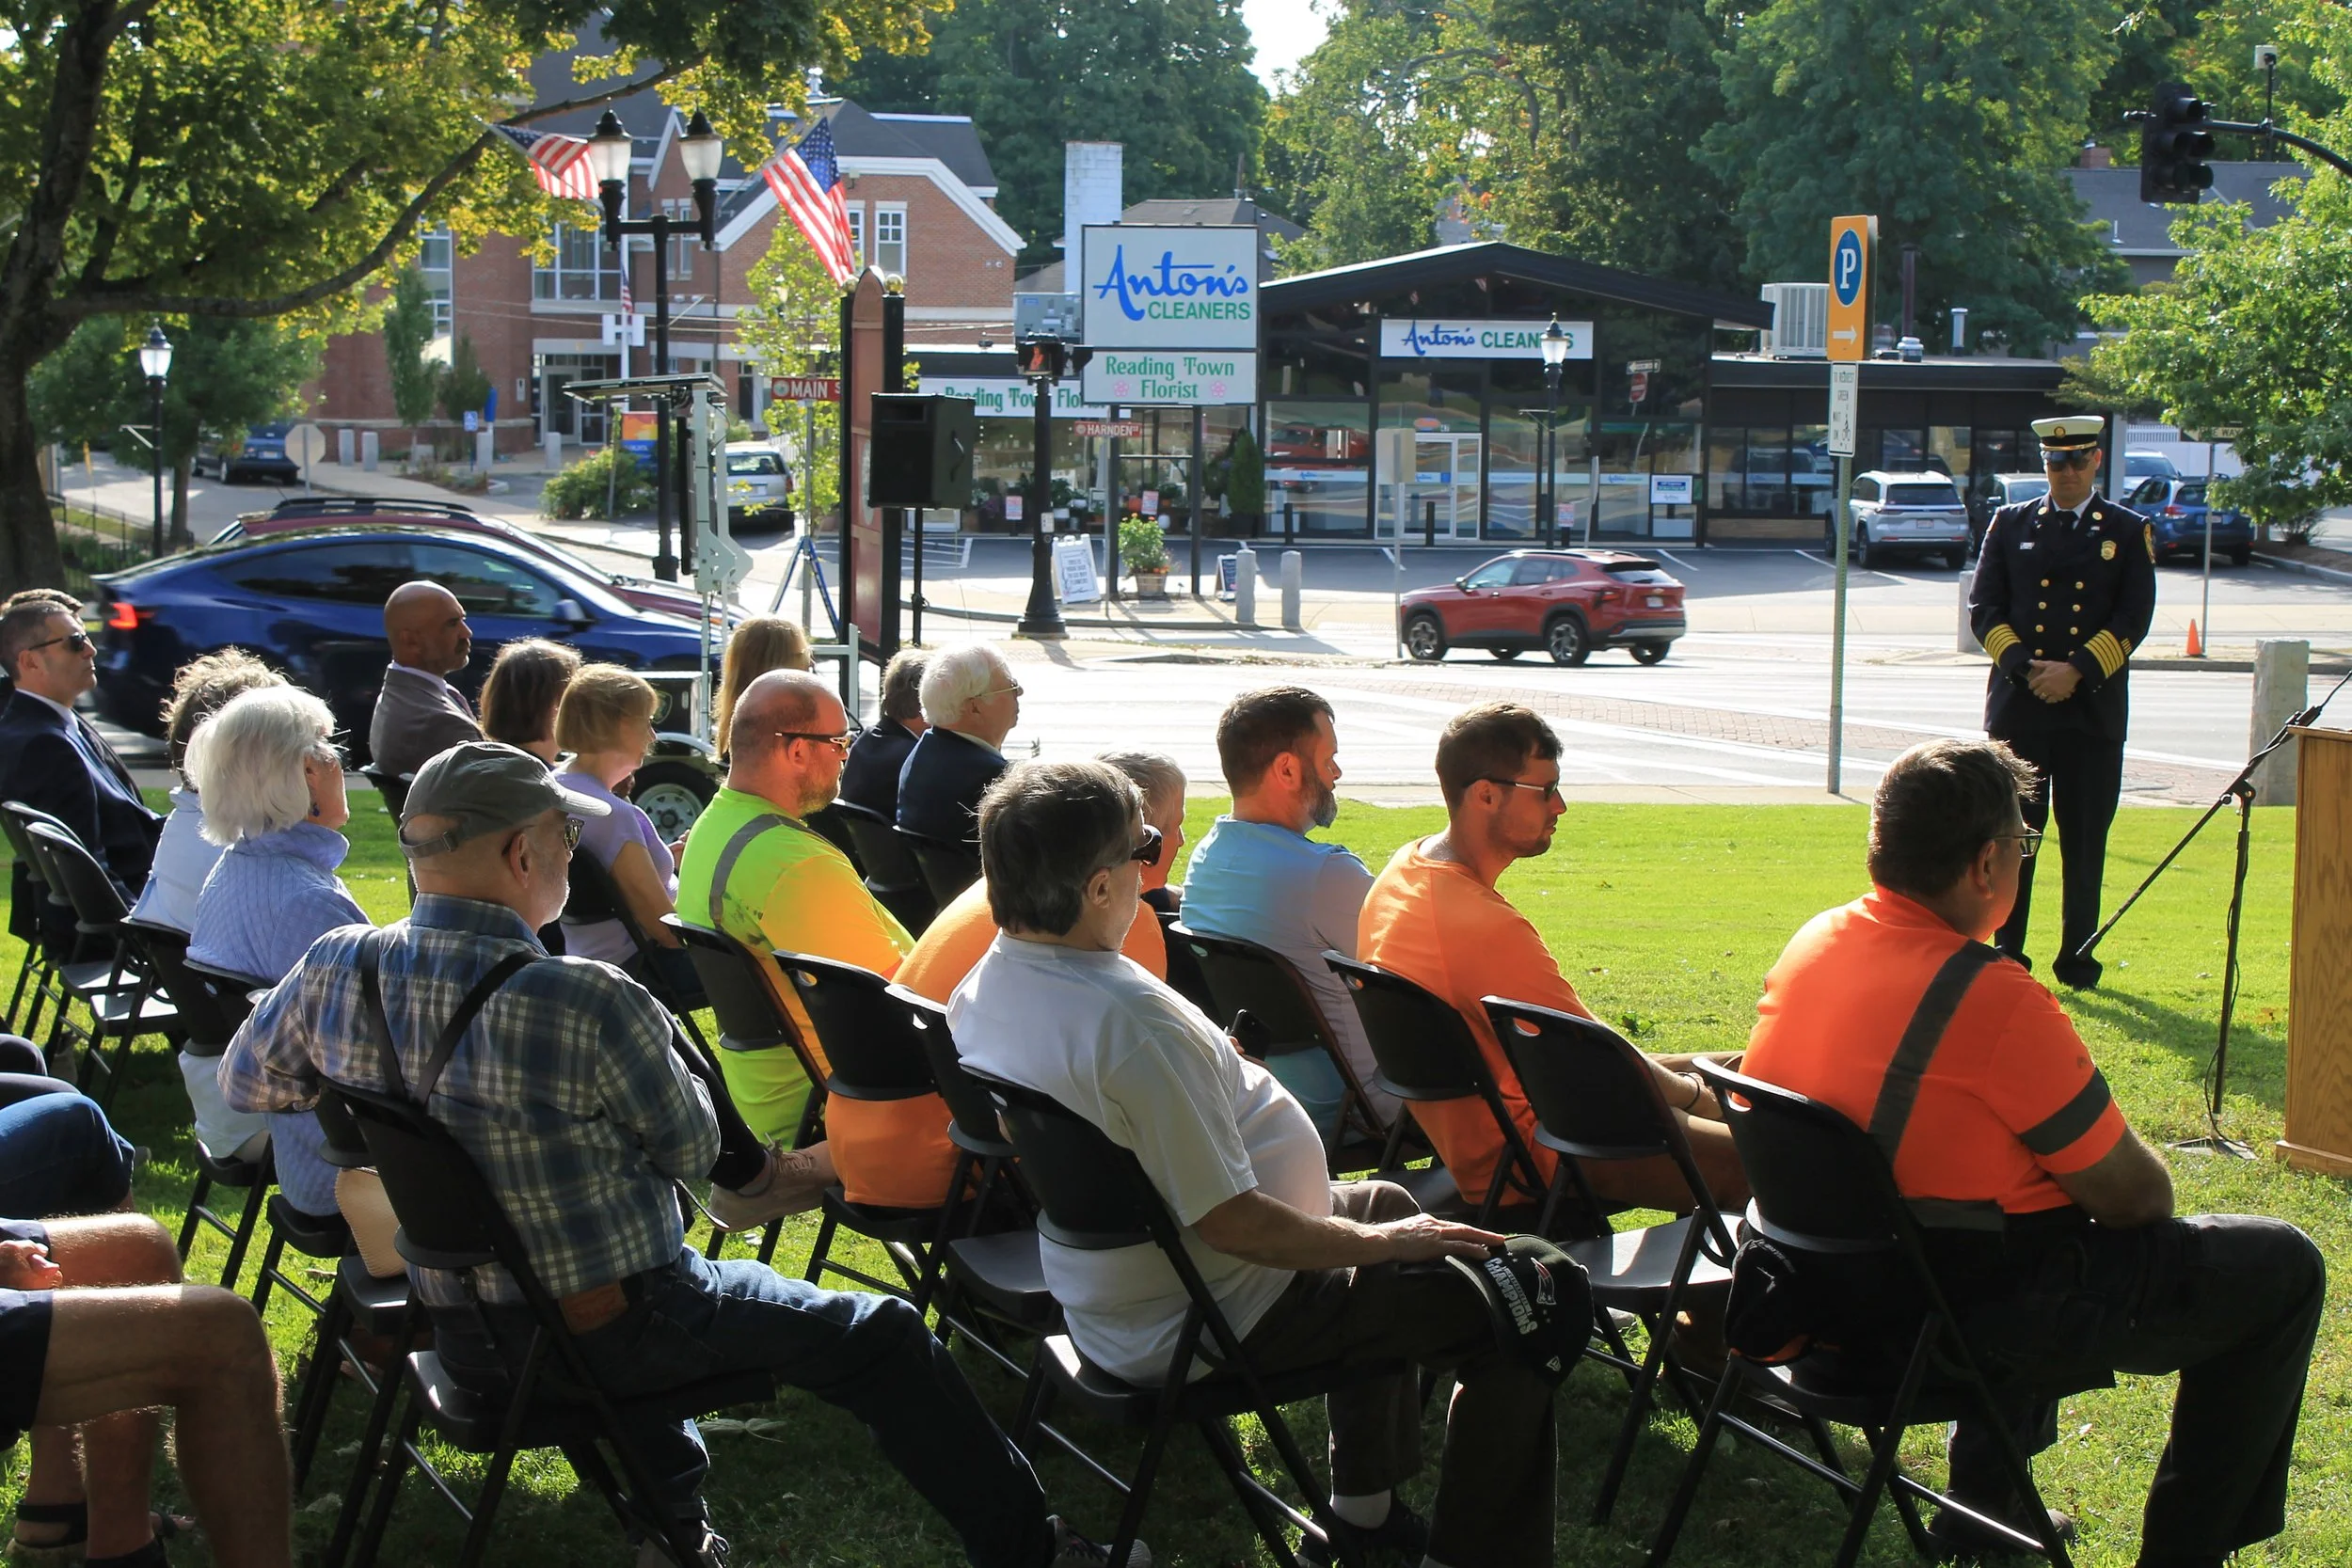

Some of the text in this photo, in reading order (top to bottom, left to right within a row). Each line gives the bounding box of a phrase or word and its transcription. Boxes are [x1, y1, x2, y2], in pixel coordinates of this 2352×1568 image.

[1839, 248, 1857, 289] P
[1092, 244, 1248, 322] Anton's
[1148, 301, 1250, 321] CLEANERS
[1400, 320, 1574, 356] Anton's CLEANS
[1105, 356, 1234, 381] Reading Town
[790, 380, 828, 398] MAIN
[1140, 379, 1199, 399] Florist
[1087, 423, 1133, 436] HARNDEN
[1484, 1257, 1538, 1335] CHAMPIONS
